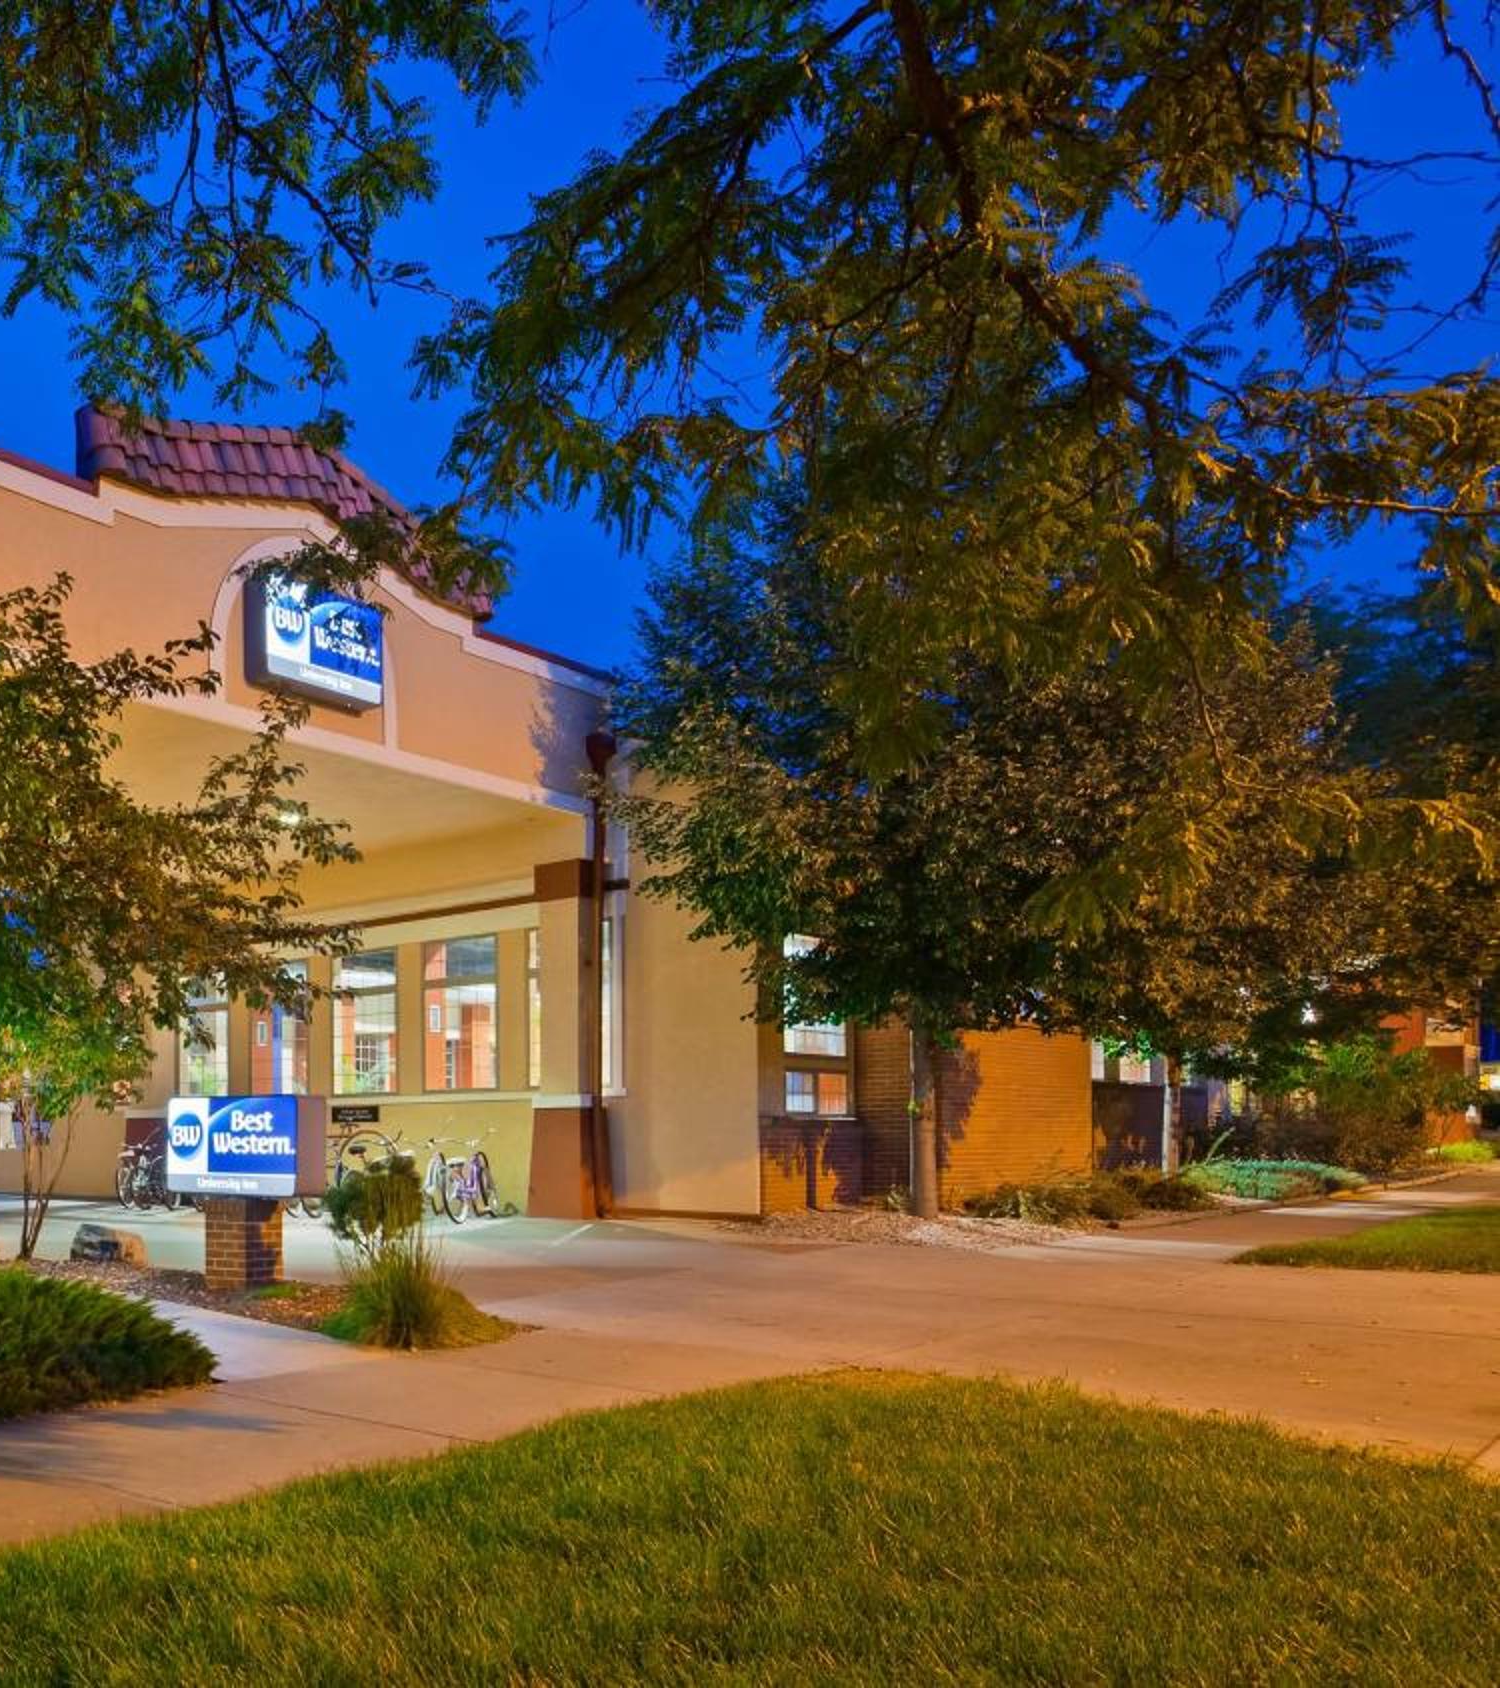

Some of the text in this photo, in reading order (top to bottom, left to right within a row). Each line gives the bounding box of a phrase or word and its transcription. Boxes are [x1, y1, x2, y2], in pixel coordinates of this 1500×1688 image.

[275, 608, 303, 633] BW
[231, 1110, 273, 1132] Best
[172, 1125, 200, 1147] BW
